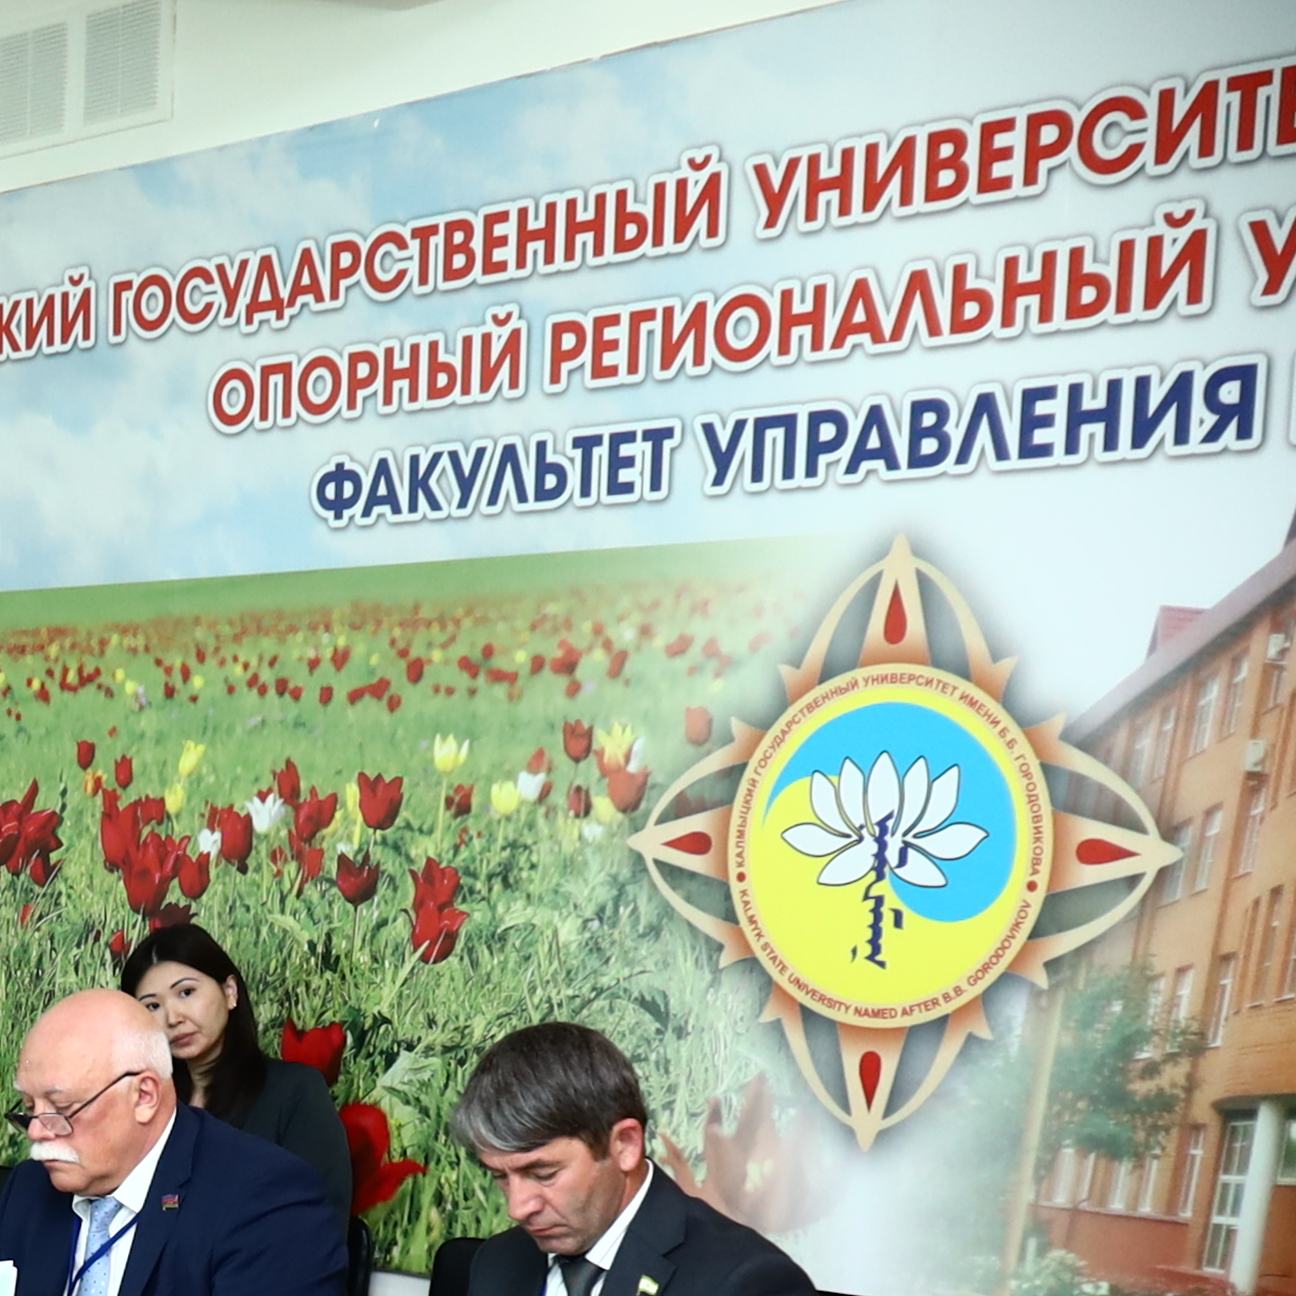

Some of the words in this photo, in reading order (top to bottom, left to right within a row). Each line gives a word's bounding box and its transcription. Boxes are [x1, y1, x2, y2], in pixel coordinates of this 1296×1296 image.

[112, 154, 722, 337] ГОСУДАРСТВЕННЫЙ
[212, 311, 521, 427] ОПОРНЫЙ
[549, 208, 1208, 385] РЕГИОНАЛЬНЫЙ
[316, 426, 674, 520] ФАКУЛЬТЕТ
[702, 363, 1259, 487] УПРАВЛЕНИЯ
[735, 778, 759, 868] КАЛМЫЦКИЙ
[754, 677, 860, 777] ГОСУДАРСТВЕННЫЙ
[863, 672, 959, 697] УНИВЕРСИТЕТ
[959, 691, 1002, 729] ИМЕНИ
[1014, 753, 1045, 877] ГОРОДОВИКОВА
[739, 888, 765, 943] KALMYK
[760, 941, 789, 976] STATE
[787, 972, 852, 1014] UNIVERSITY
[853, 1005, 898, 1020] NAMED
[900, 997, 942, 1018] AFTER
[966, 899, 1033, 987] GORODOVIKOV
